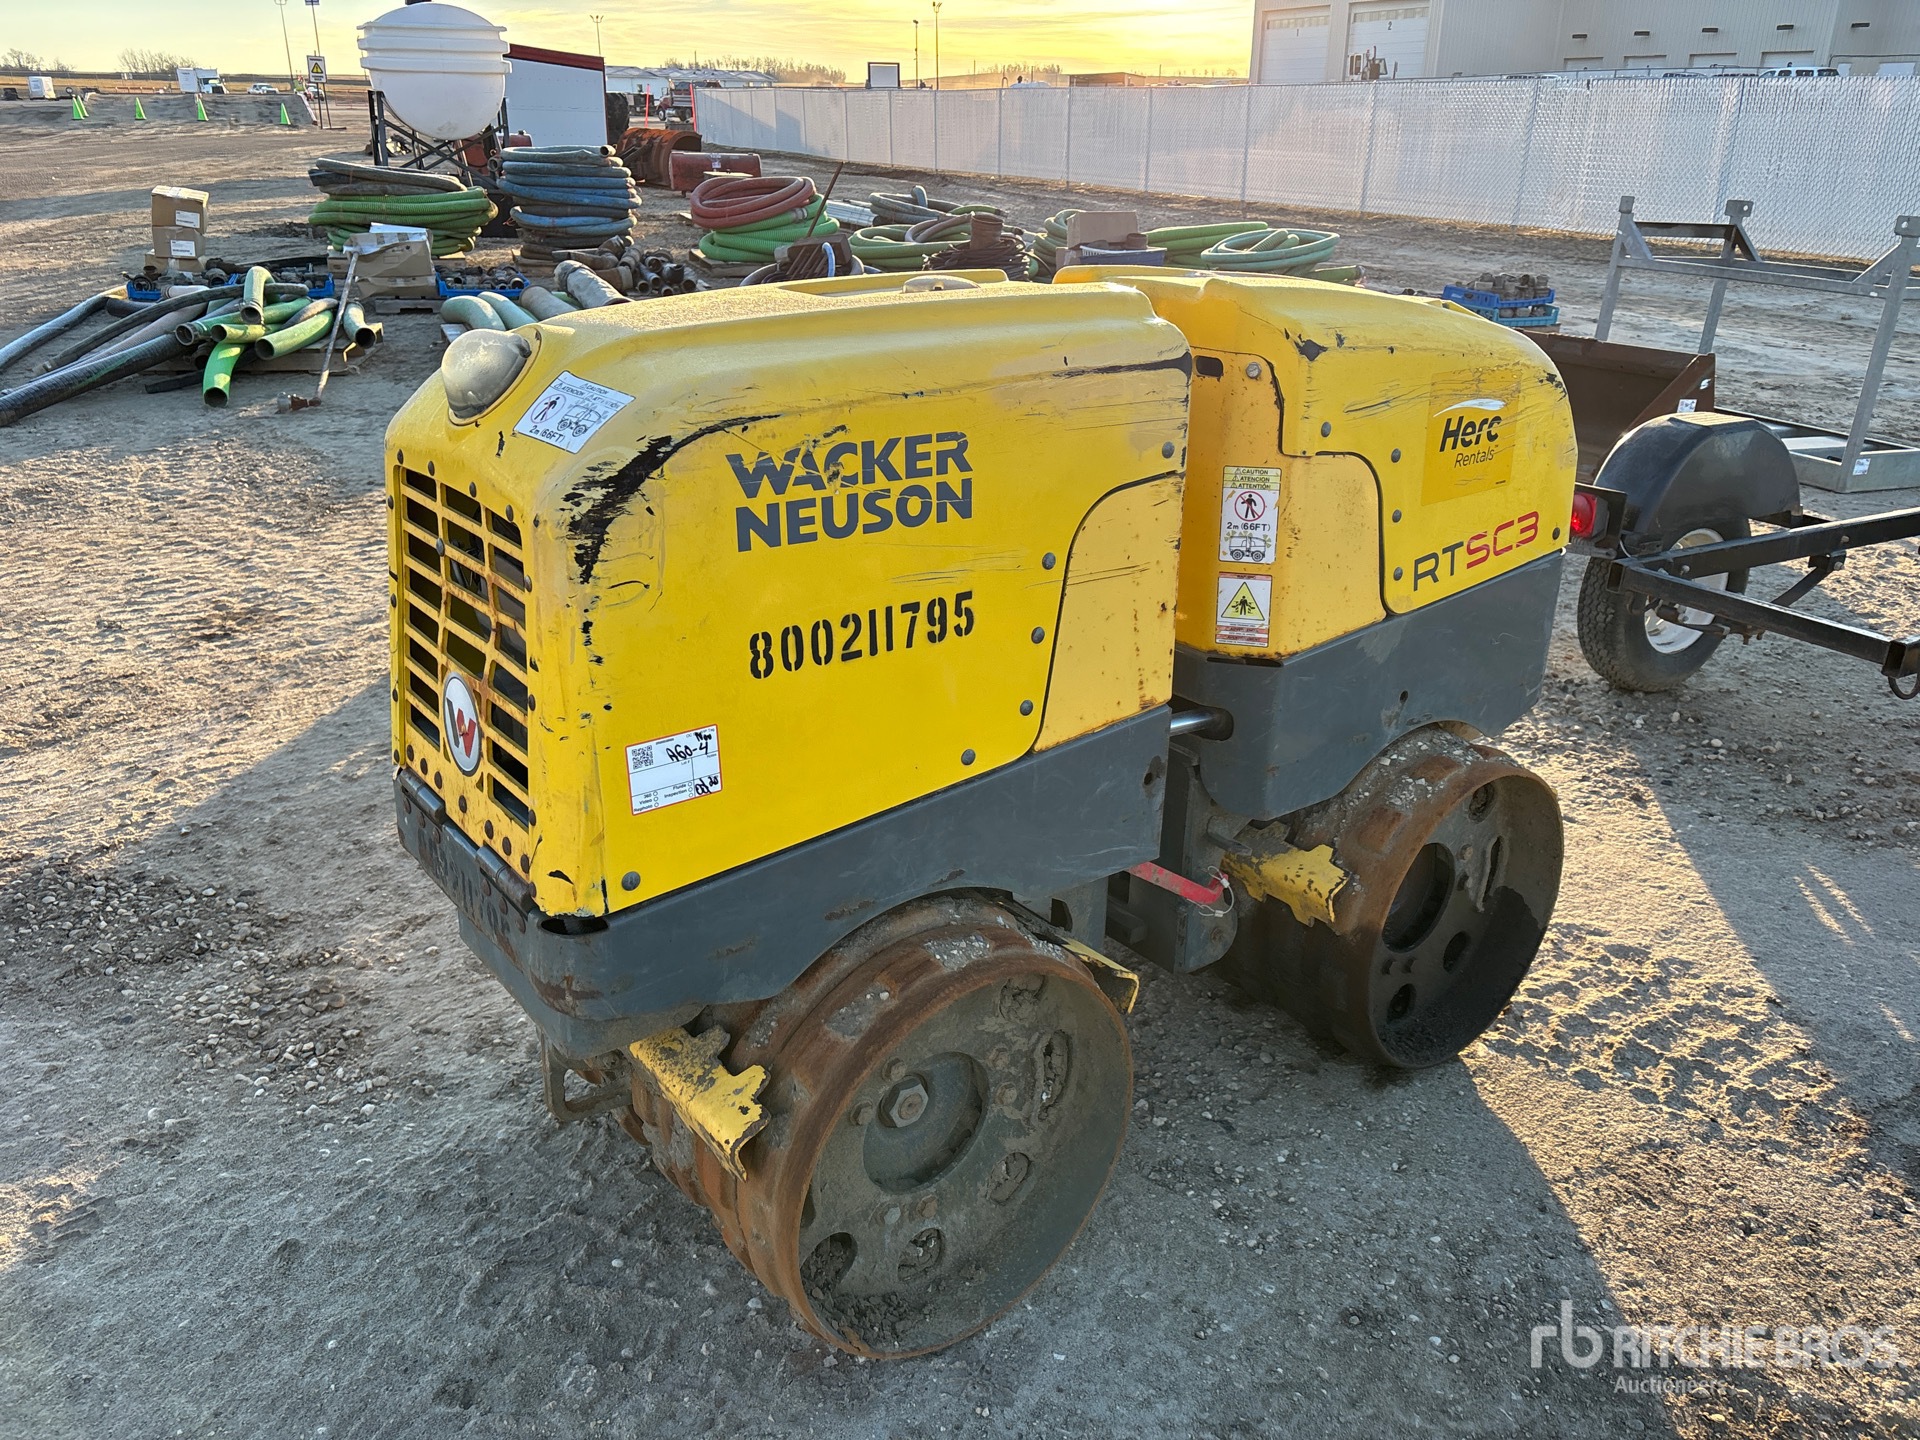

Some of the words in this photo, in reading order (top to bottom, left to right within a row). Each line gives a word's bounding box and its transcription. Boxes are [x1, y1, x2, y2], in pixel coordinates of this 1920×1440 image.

[1387, 21, 1392, 30] 2
[1439, 415, 1502, 452] Herc
[1454, 446, 1495, 468] Rentals
[725, 431, 973, 499] WACKER
[736, 478, 973, 553] NEUSON
[1226, 521, 1239, 530] 2m
[1413, 510, 1540, 592] RTSC3
[749, 589, 975, 680] 800211795
